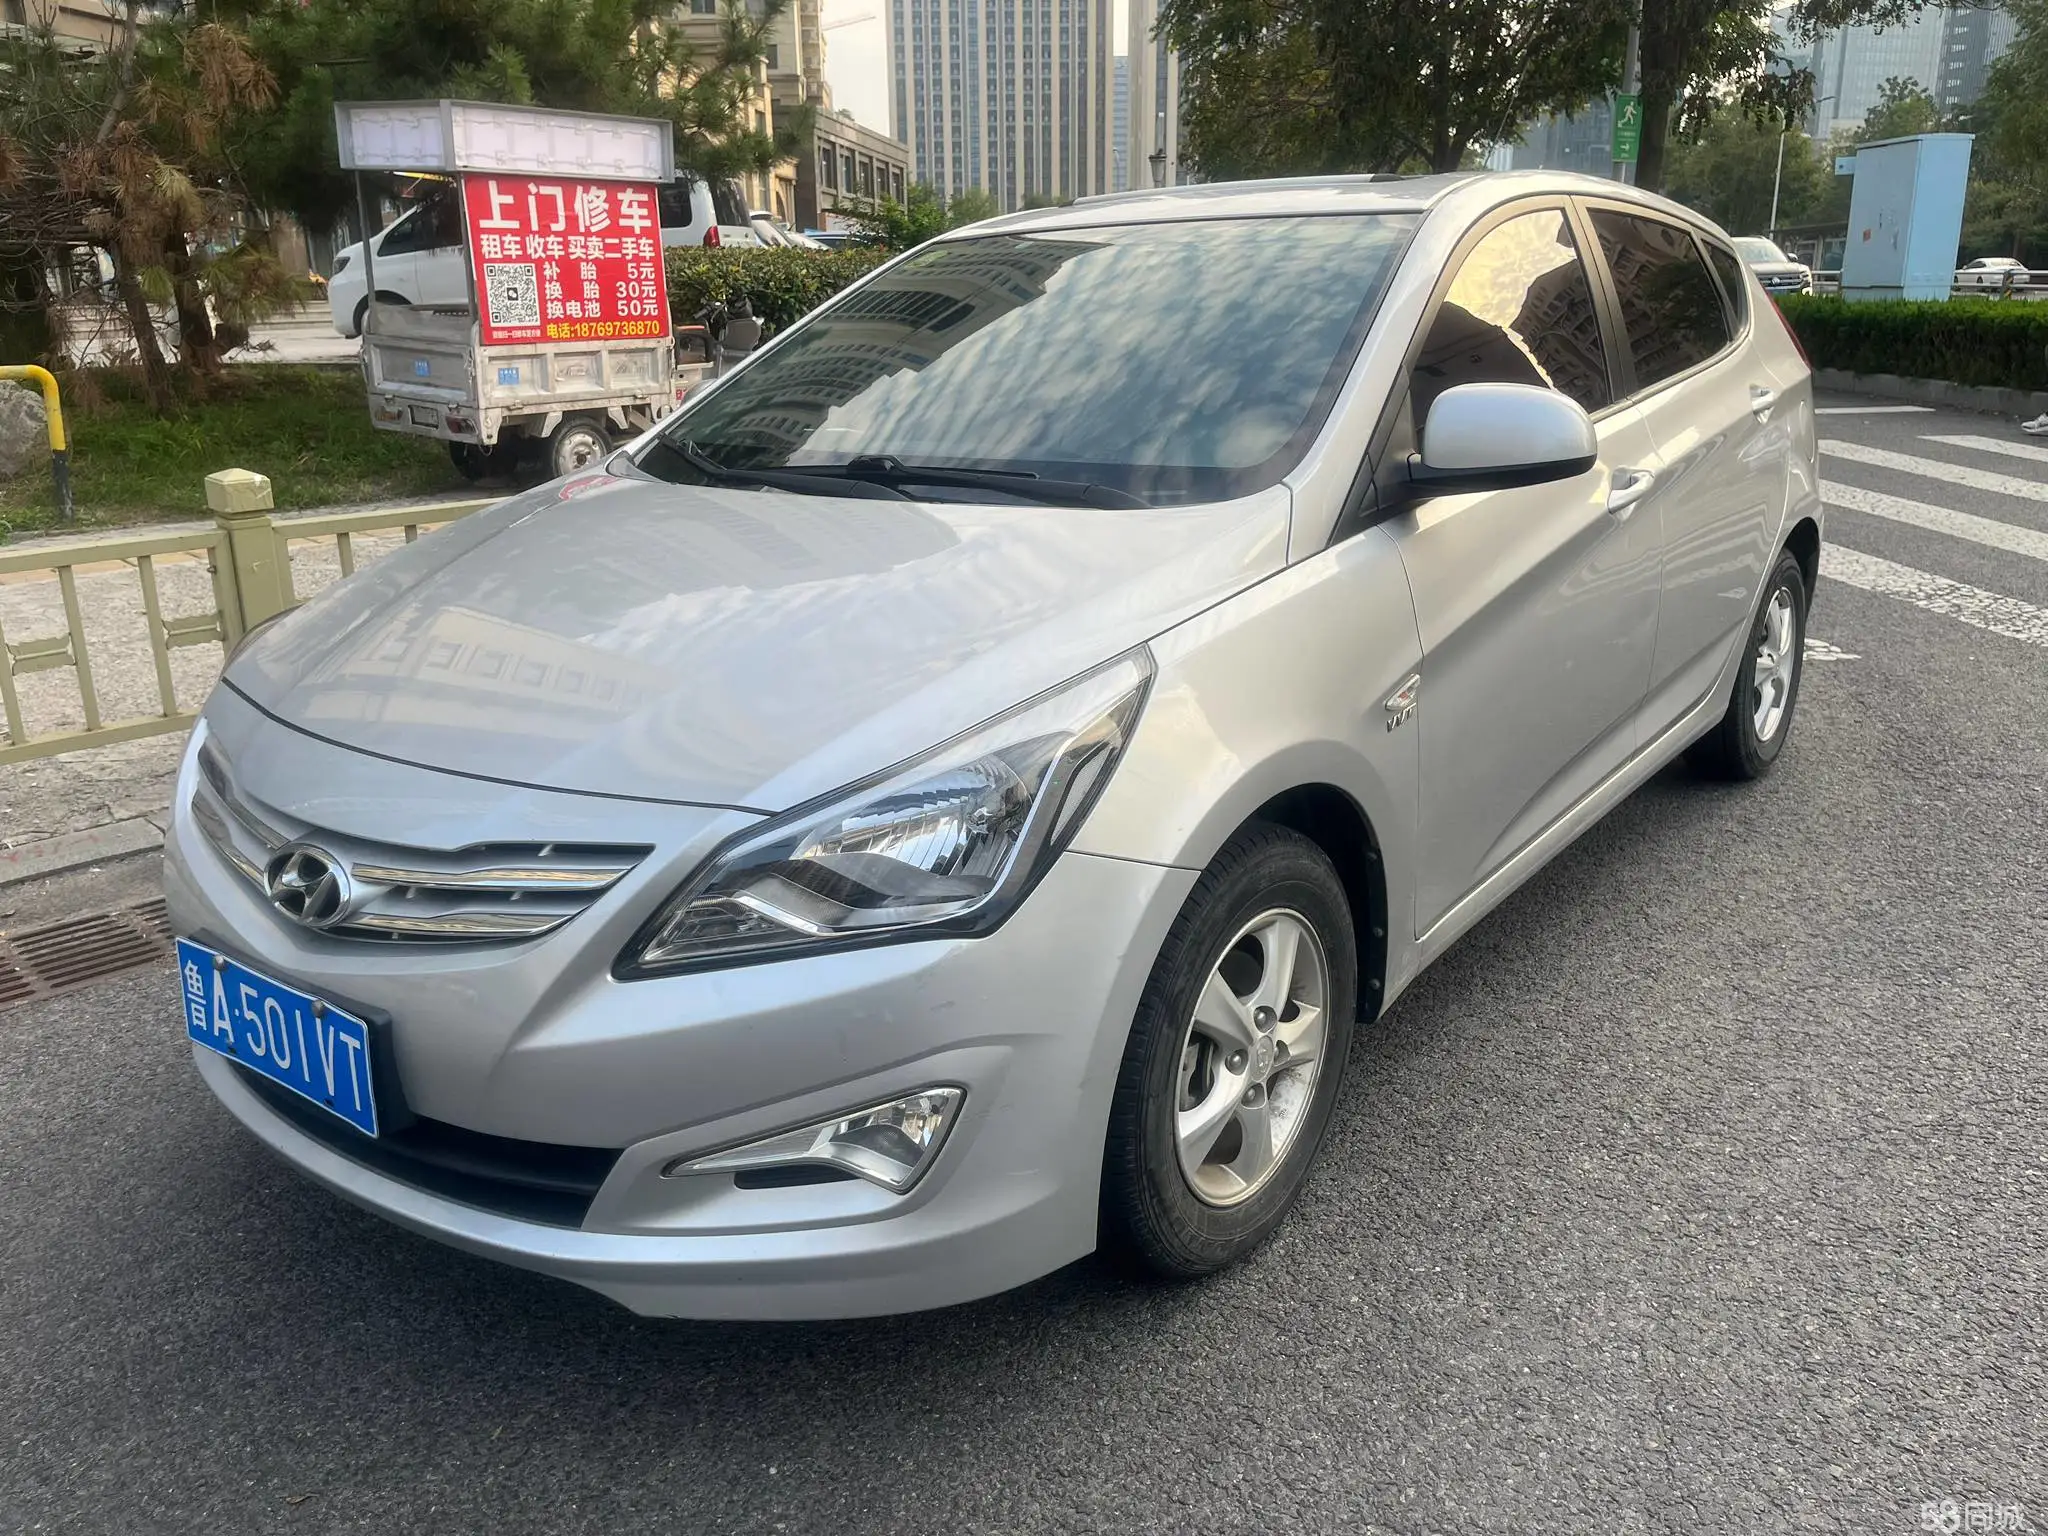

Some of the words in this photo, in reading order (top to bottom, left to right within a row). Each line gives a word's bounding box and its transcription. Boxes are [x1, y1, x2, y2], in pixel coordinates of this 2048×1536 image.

[479, 180, 652, 234] 上门修车
[480, 234, 522, 259] 租车
[525, 235, 565, 259] 收车
[568, 235, 655, 260] 买卖二手车
[627, 262, 655, 280] 5元
[616, 281, 657, 299] 30元
[546, 300, 601, 319] 换电池
[617, 300, 659, 317] 50元
